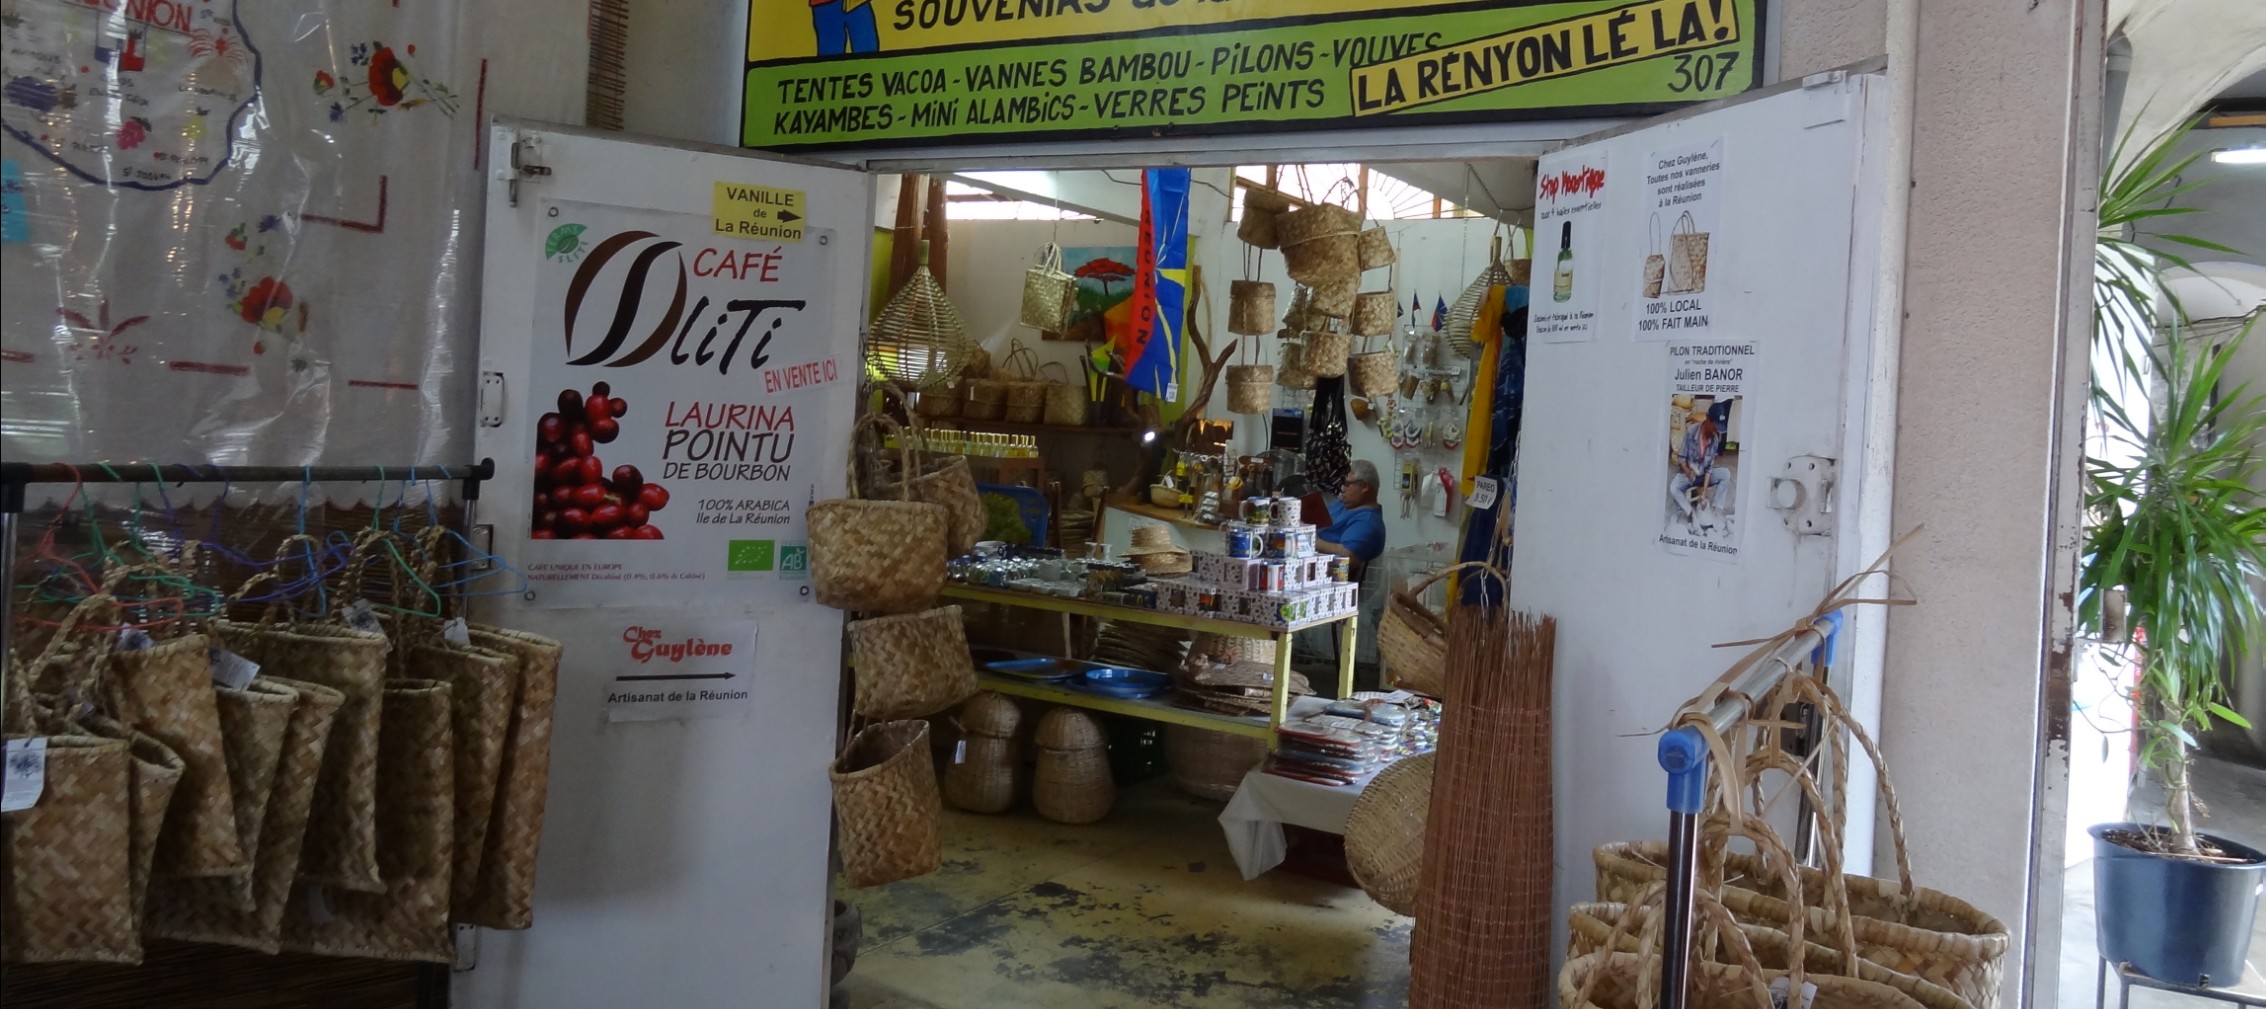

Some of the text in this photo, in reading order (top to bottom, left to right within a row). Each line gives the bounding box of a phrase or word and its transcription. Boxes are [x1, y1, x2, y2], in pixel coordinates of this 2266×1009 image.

[1357, 67, 1407, 112] LA
[1583, 11, 1640, 64] LÉ
[1654, 0, 1730, 49] LA!
[778, 69, 874, 105] TENTES
[881, 66, 947, 97] VACOA
[964, 59, 1068, 93] VANNES
[1078, 47, 1192, 86] BAMBOU
[1666, 51, 1740, 93] 307
[773, 104, 894, 136] KAYAMBES
[1096, 85, 1206, 119] VERRES
[1658, 151, 1709, 170] Chez Guylène,
[1647, 162, 1720, 185] Toutes nos vanneries
[726, 187, 795, 208] VANILLE
[1539, 173, 1559, 205] Stop
[1657, 179, 1706, 195] sont réalisées
[1658, 192, 1702, 208] à la Réunion
[753, 208, 768, 219] de
[715, 218, 802, 240] La Réunion
[693, 246, 783, 282] CAFÉ
[1646, 299, 1702, 315] 100% LOCAL
[1639, 315, 1709, 332] 100% FAIT MAIN
[1669, 345, 1755, 356] PILON TRADITIONNEL
[764, 358, 838, 394] EN VENTE ICI
[1674, 368, 1744, 381] Julien BANOR
[1676, 384, 1740, 393] TAILLEUR DE PIERRE
[664, 401, 796, 432] LAURINA
[662, 429, 796, 464] POINTU
[663, 461, 791, 482] DE BOURBON
[1476, 480, 1495, 493] PAREO
[698, 499, 790, 511] 100% ARABICA
[711, 512, 727, 524] de
[729, 512, 743, 524] La
[745, 512, 790, 524] Réunion
[1659, 534, 1738, 556] Artisanat de la Réunion
[623, 625, 662, 643] Chez
[630, 638, 733, 664] Guylène
[608, 689, 748, 704] Artisanat de la Réunion
